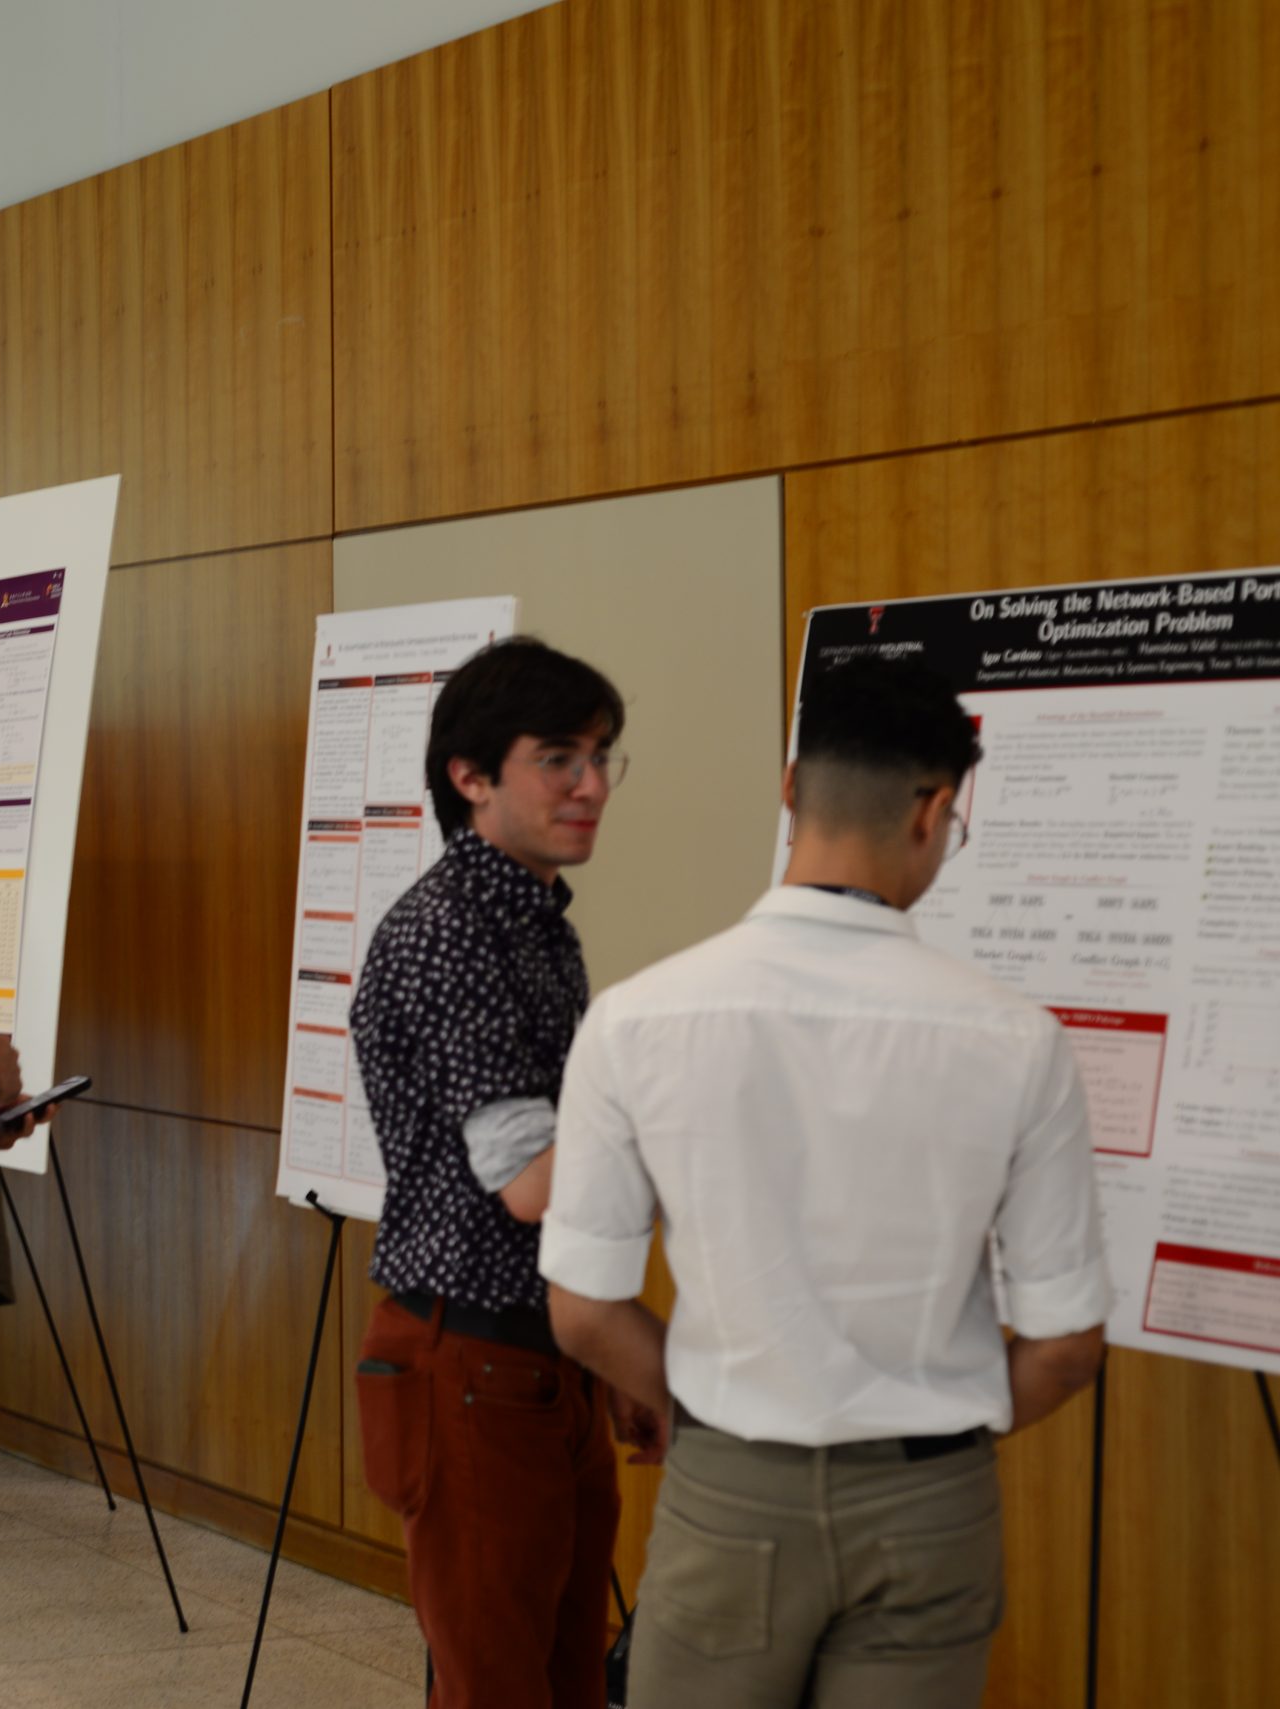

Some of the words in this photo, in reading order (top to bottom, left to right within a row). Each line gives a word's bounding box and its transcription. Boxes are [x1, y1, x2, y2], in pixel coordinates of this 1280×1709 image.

[970, 598, 995, 621] On
[999, 595, 1059, 619] Solving
[1063, 592, 1093, 614] the
[1097, 580, 1236, 611] Network-Based
[1038, 614, 1150, 646] Optimization
[1154, 610, 1234, 635] Problem
